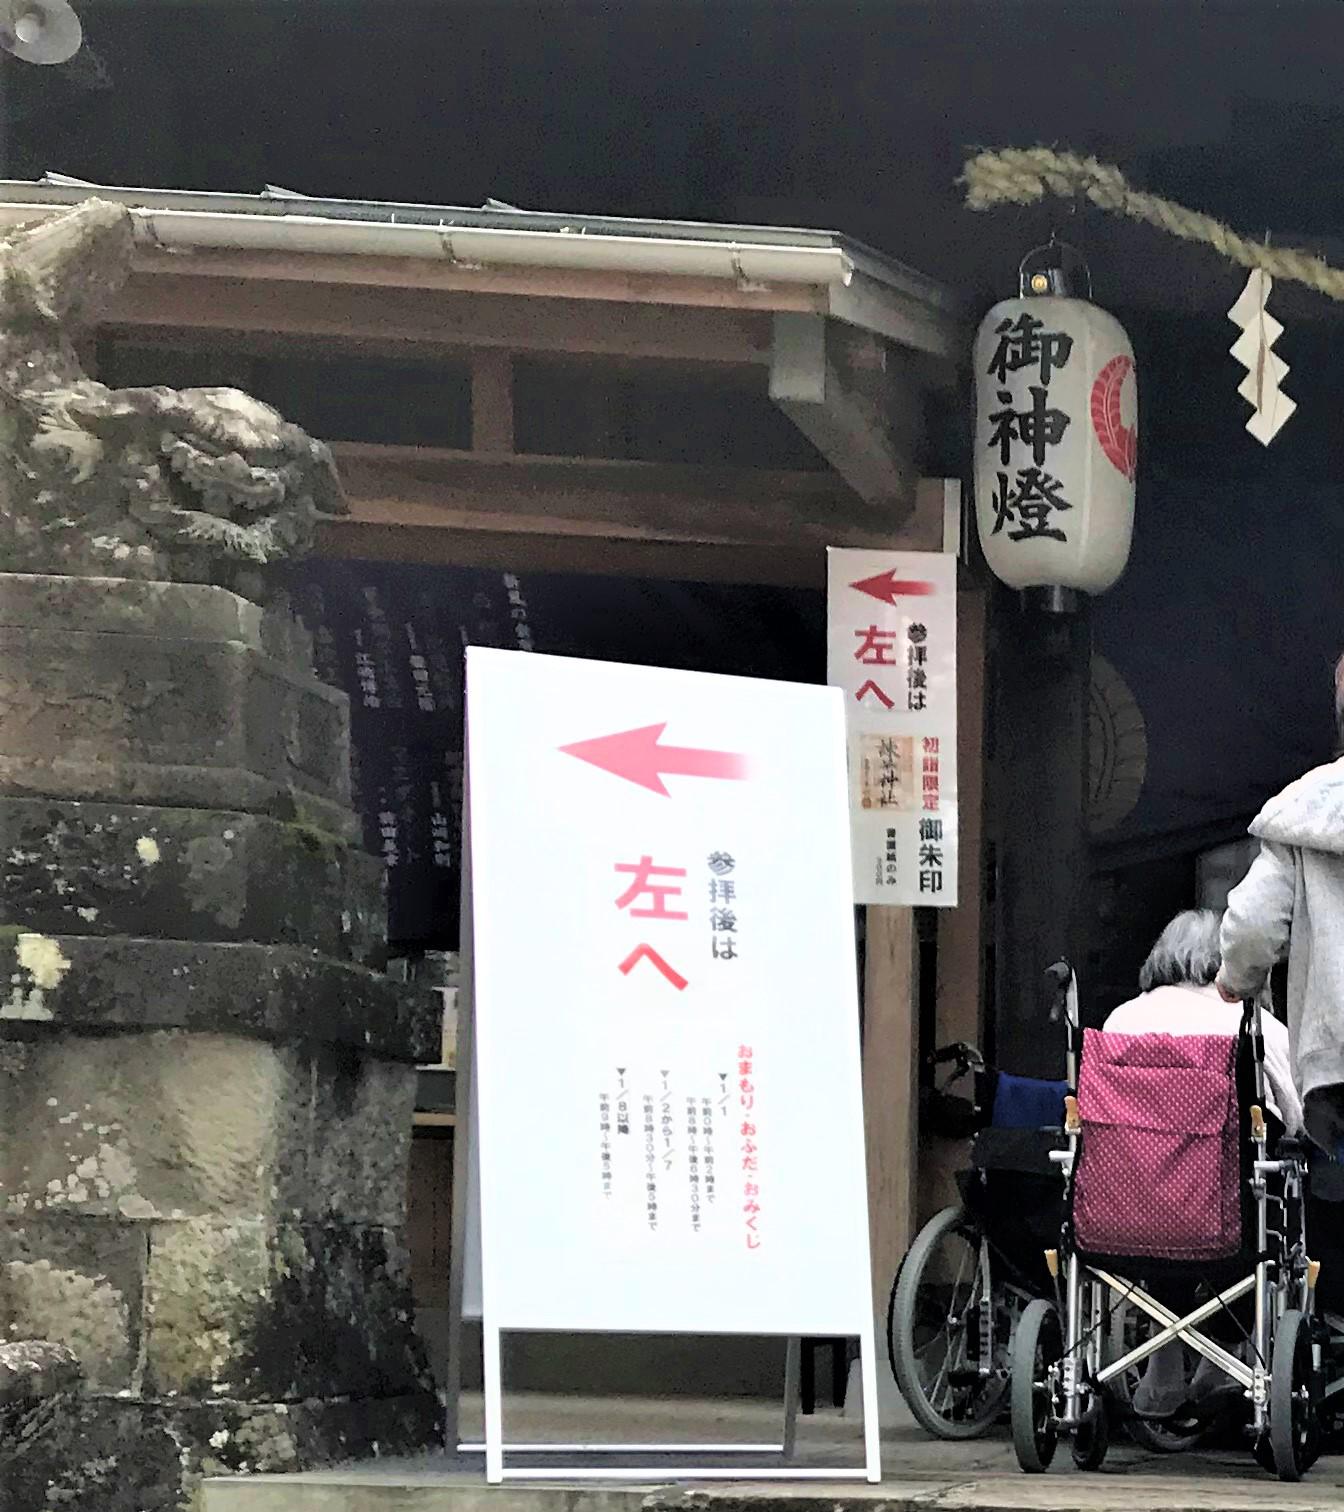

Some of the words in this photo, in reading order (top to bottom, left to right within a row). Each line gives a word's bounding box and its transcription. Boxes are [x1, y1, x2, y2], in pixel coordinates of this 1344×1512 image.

[987, 313, 1073, 543] 御神燈
[854, 625, 897, 710] 左へ
[907, 622, 928, 712] 参拝後は
[919, 817, 943, 893] 御朱印
[614, 855, 689, 991] 左へ
[707, 851, 738, 960] 参拝後は
